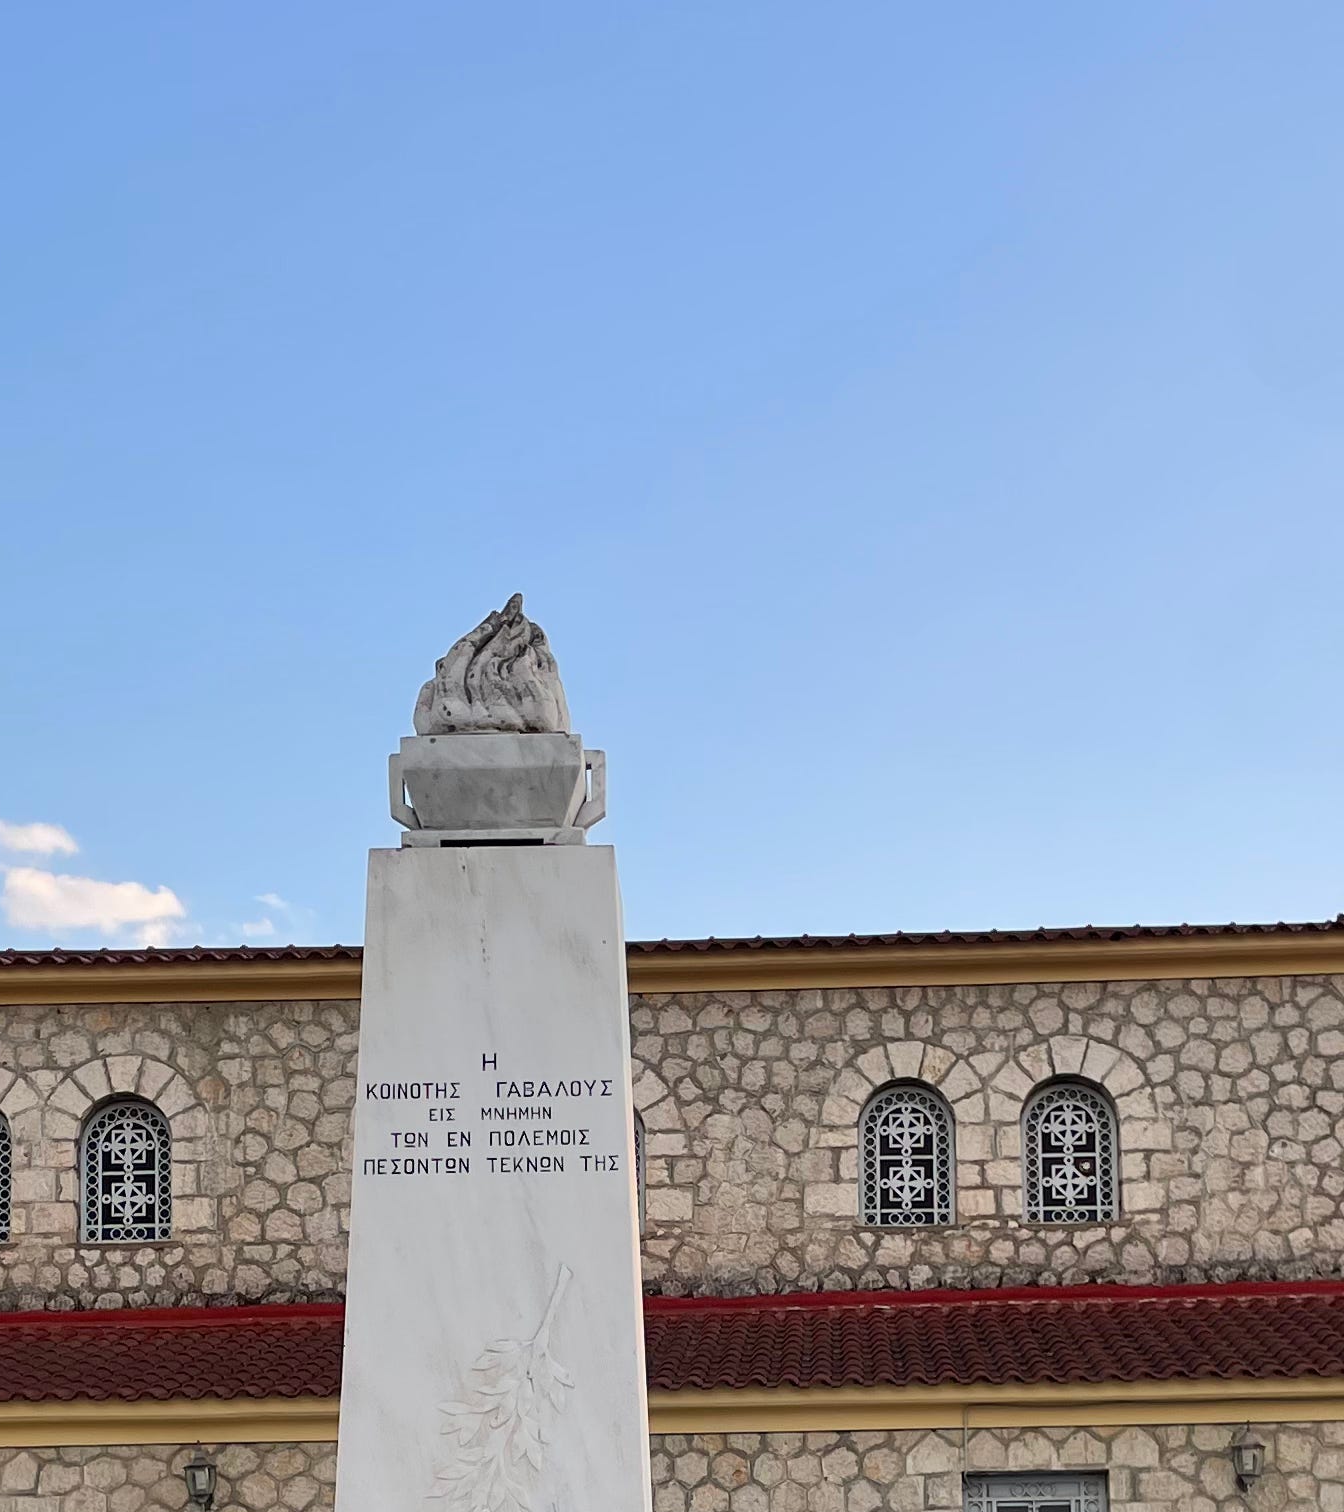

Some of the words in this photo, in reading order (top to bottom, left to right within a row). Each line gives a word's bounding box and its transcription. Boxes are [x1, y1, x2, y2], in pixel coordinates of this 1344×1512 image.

[482, 1052, 497, 1072] Η
[366, 1082, 460, 1100] ΚΟΙΝΟΤΗΣ
[496, 1079, 613, 1098] ΓΑΒΑΛΟΥΣ
[429, 1108, 456, 1122] ΕΙΣ
[481, 1106, 552, 1121] ΜΝΗΜΗΝ
[390, 1132, 428, 1148] ΤΩΝ
[447, 1131, 471, 1148] ΕΝ
[489, 1129, 590, 1147] ΠΟΛΕΜΟΙΣ
[363, 1157, 470, 1176] ΠΕΣΟΝΤΩΝ
[486, 1156, 564, 1173] ΤΕΚΝΩΝ
[579, 1154, 619, 1172] ΤΗΣ
